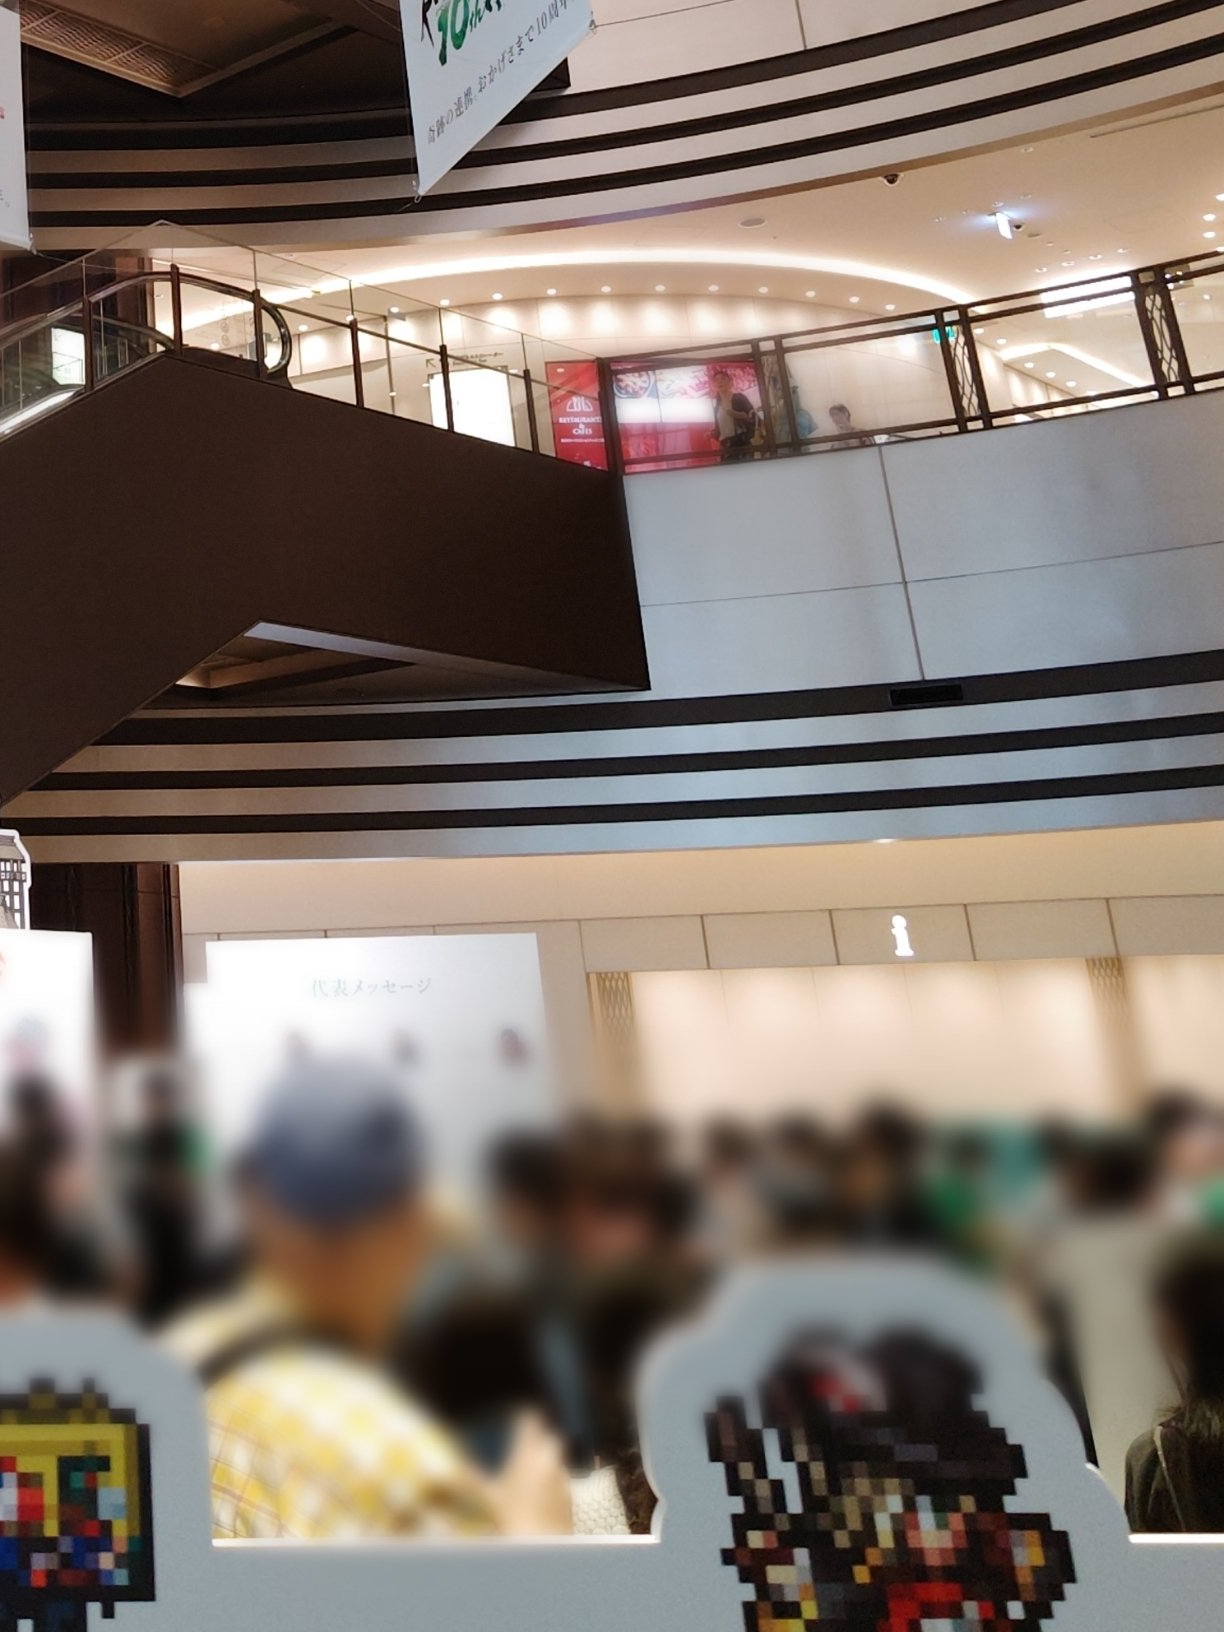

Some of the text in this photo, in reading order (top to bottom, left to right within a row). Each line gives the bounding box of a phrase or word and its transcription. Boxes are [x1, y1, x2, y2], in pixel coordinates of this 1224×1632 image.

[312, 977, 433, 999] 代表メッセージ
